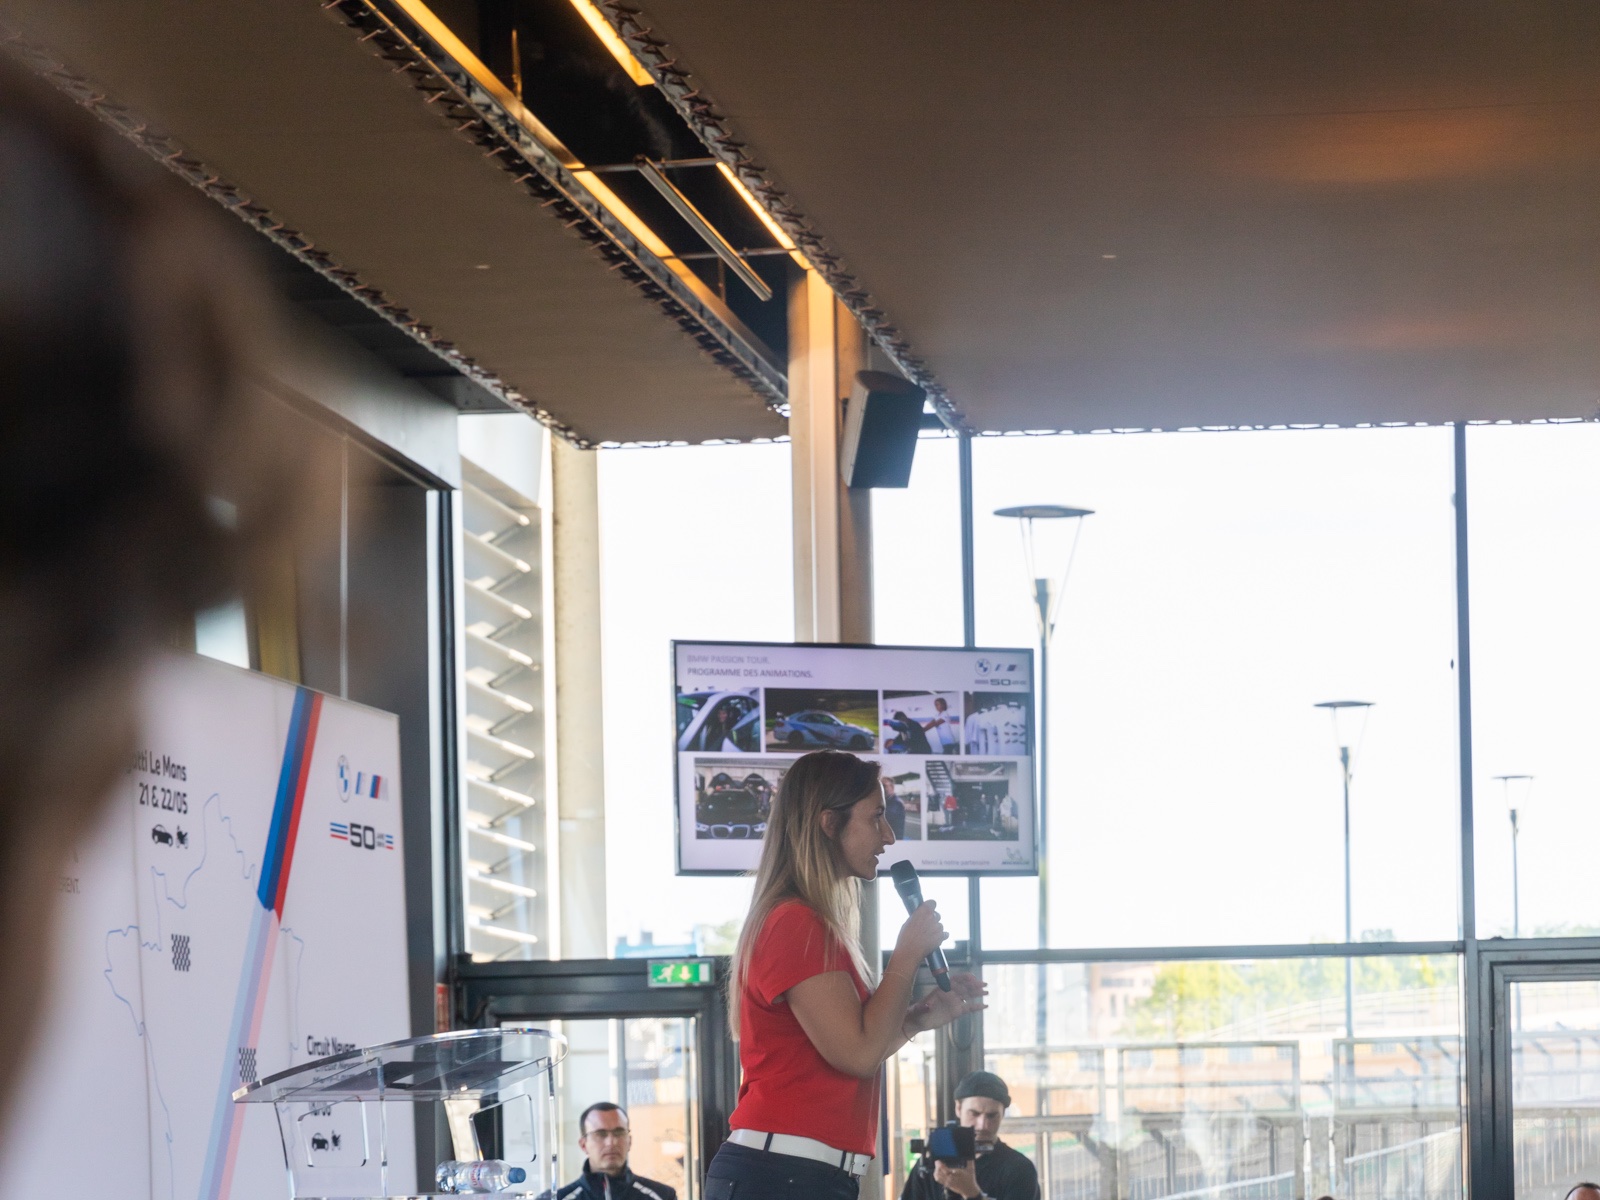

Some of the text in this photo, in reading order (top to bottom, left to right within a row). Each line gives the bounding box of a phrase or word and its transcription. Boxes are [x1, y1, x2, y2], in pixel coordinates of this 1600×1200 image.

[711, 655, 744, 664] PASSION
[687, 667, 813, 678] PROGRAMME DES ANIMATIONS.
[149, 751, 161, 776] Le
[162, 754, 187, 782] Mans
[139, 782, 188, 815] 21 & 22/05
[350, 822, 376, 850] 50
[306, 1035, 330, 1056] Circuit
